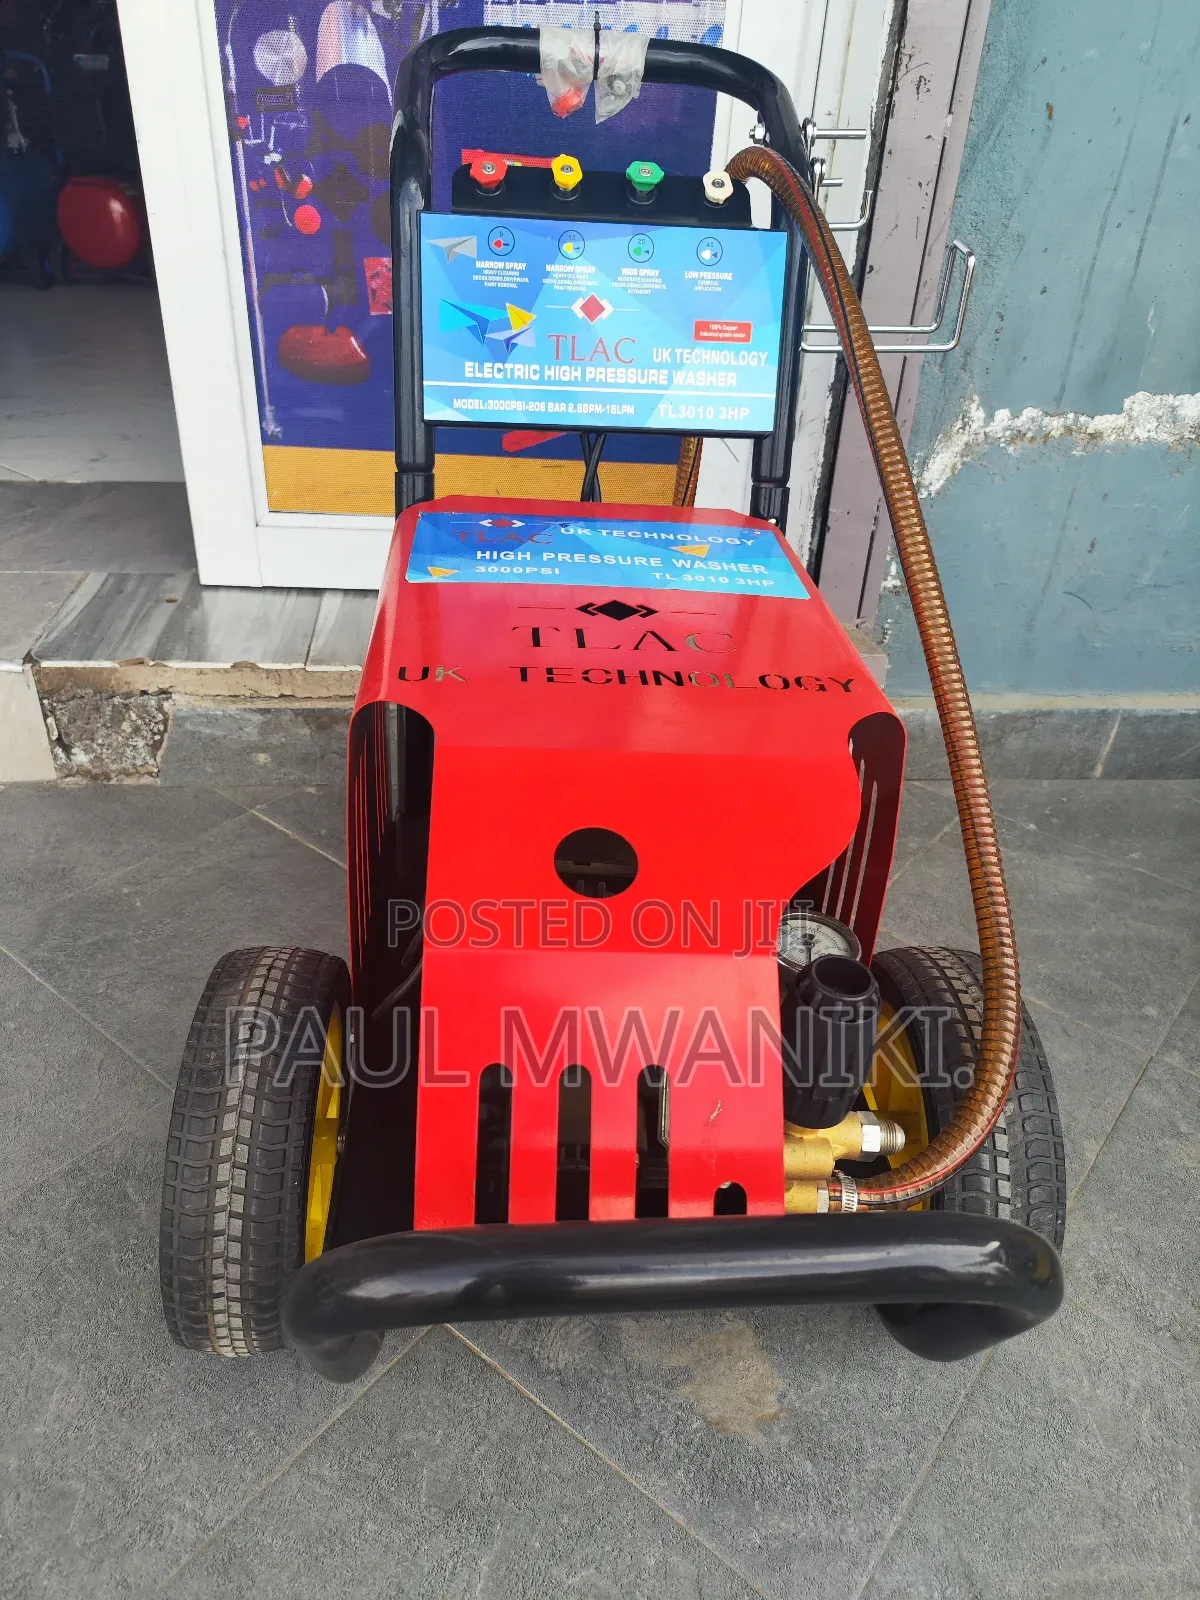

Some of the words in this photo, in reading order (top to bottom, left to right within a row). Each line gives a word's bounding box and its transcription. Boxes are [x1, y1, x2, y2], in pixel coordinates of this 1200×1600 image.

[475, 260, 504, 269] NARROW
[505, 261, 527, 271] SPRAY
[545, 263, 574, 273] NARROW
[574, 265, 597, 274] SPRAY
[621, 267, 638, 276] WIDE
[638, 268, 660, 277] SPRAY
[684, 270, 699, 279] LOW
[699, 271, 733, 281] PRESSURE
[547, 333, 636, 364] TLAC
[652, 347, 672, 364] UK
[675, 348, 769, 367] TECHNOLOGY
[464, 361, 541, 381] ELECTRIC
[544, 364, 582, 383] HIGH
[585, 366, 669, 385] PRESSURE
[672, 370, 738, 388] WASHER
[547, 401, 566, 413] BAR
[658, 404, 715, 420] TL3010
[718, 406, 750, 421] 3HP
[452, 529, 552, 545] TLAC
[560, 526, 593, 537] UK
[597, 528, 755, 547] TECHNOLOGY
[475, 565, 560, 575] 3000PSI
[476, 550, 531, 561] HIGH
[542, 551, 664, 568] PRESSURE
[671, 558, 769, 575] WASHER
[651, 572, 677, 581] TL
[682, 574, 729, 584] 3010
[734, 576, 775, 588] 3HP
[511, 625, 737, 654] TLAC
[397, 664, 467, 682] UK
[508, 665, 856, 693] TECHNOLOGY
